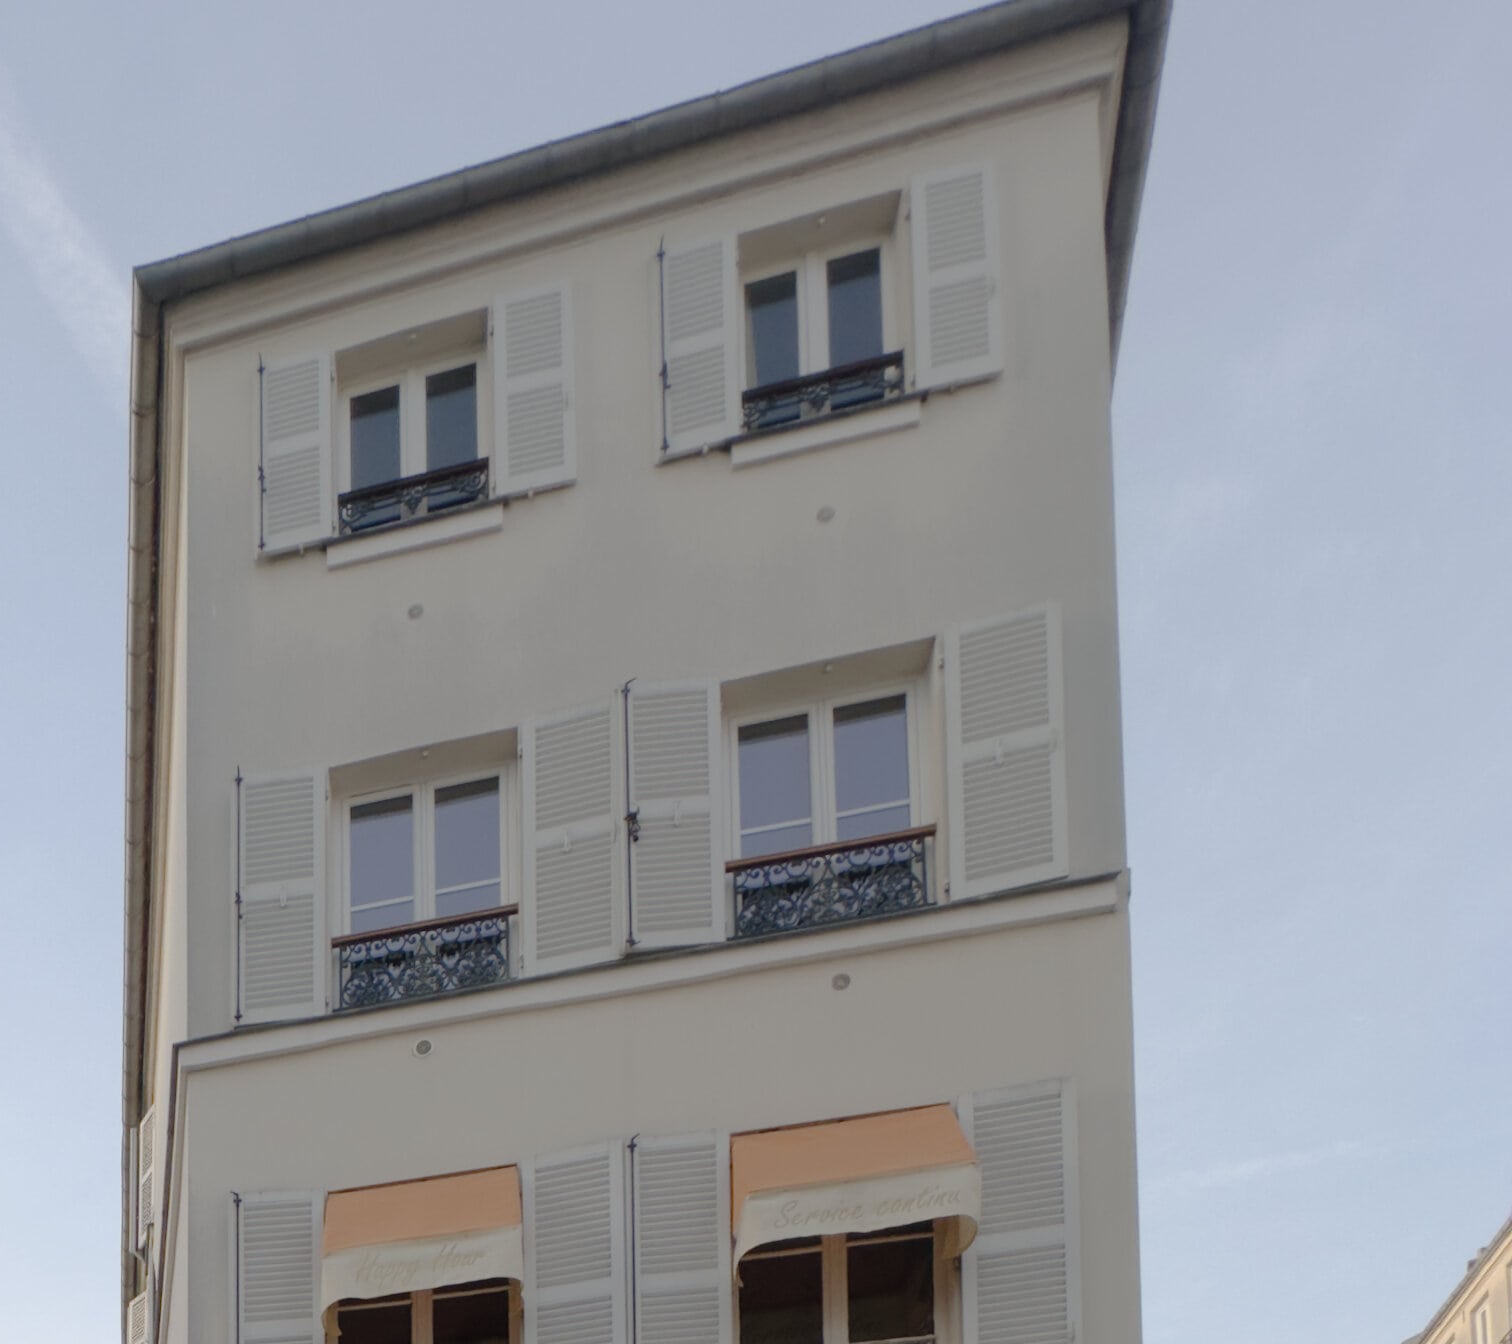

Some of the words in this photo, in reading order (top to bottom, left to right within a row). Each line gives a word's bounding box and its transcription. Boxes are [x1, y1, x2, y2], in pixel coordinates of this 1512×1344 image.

[773, 1199, 864, 1229] Service
[875, 1184, 962, 1217] continu
[353, 1252, 420, 1289] Happy
[431, 1242, 486, 1273] Hour
